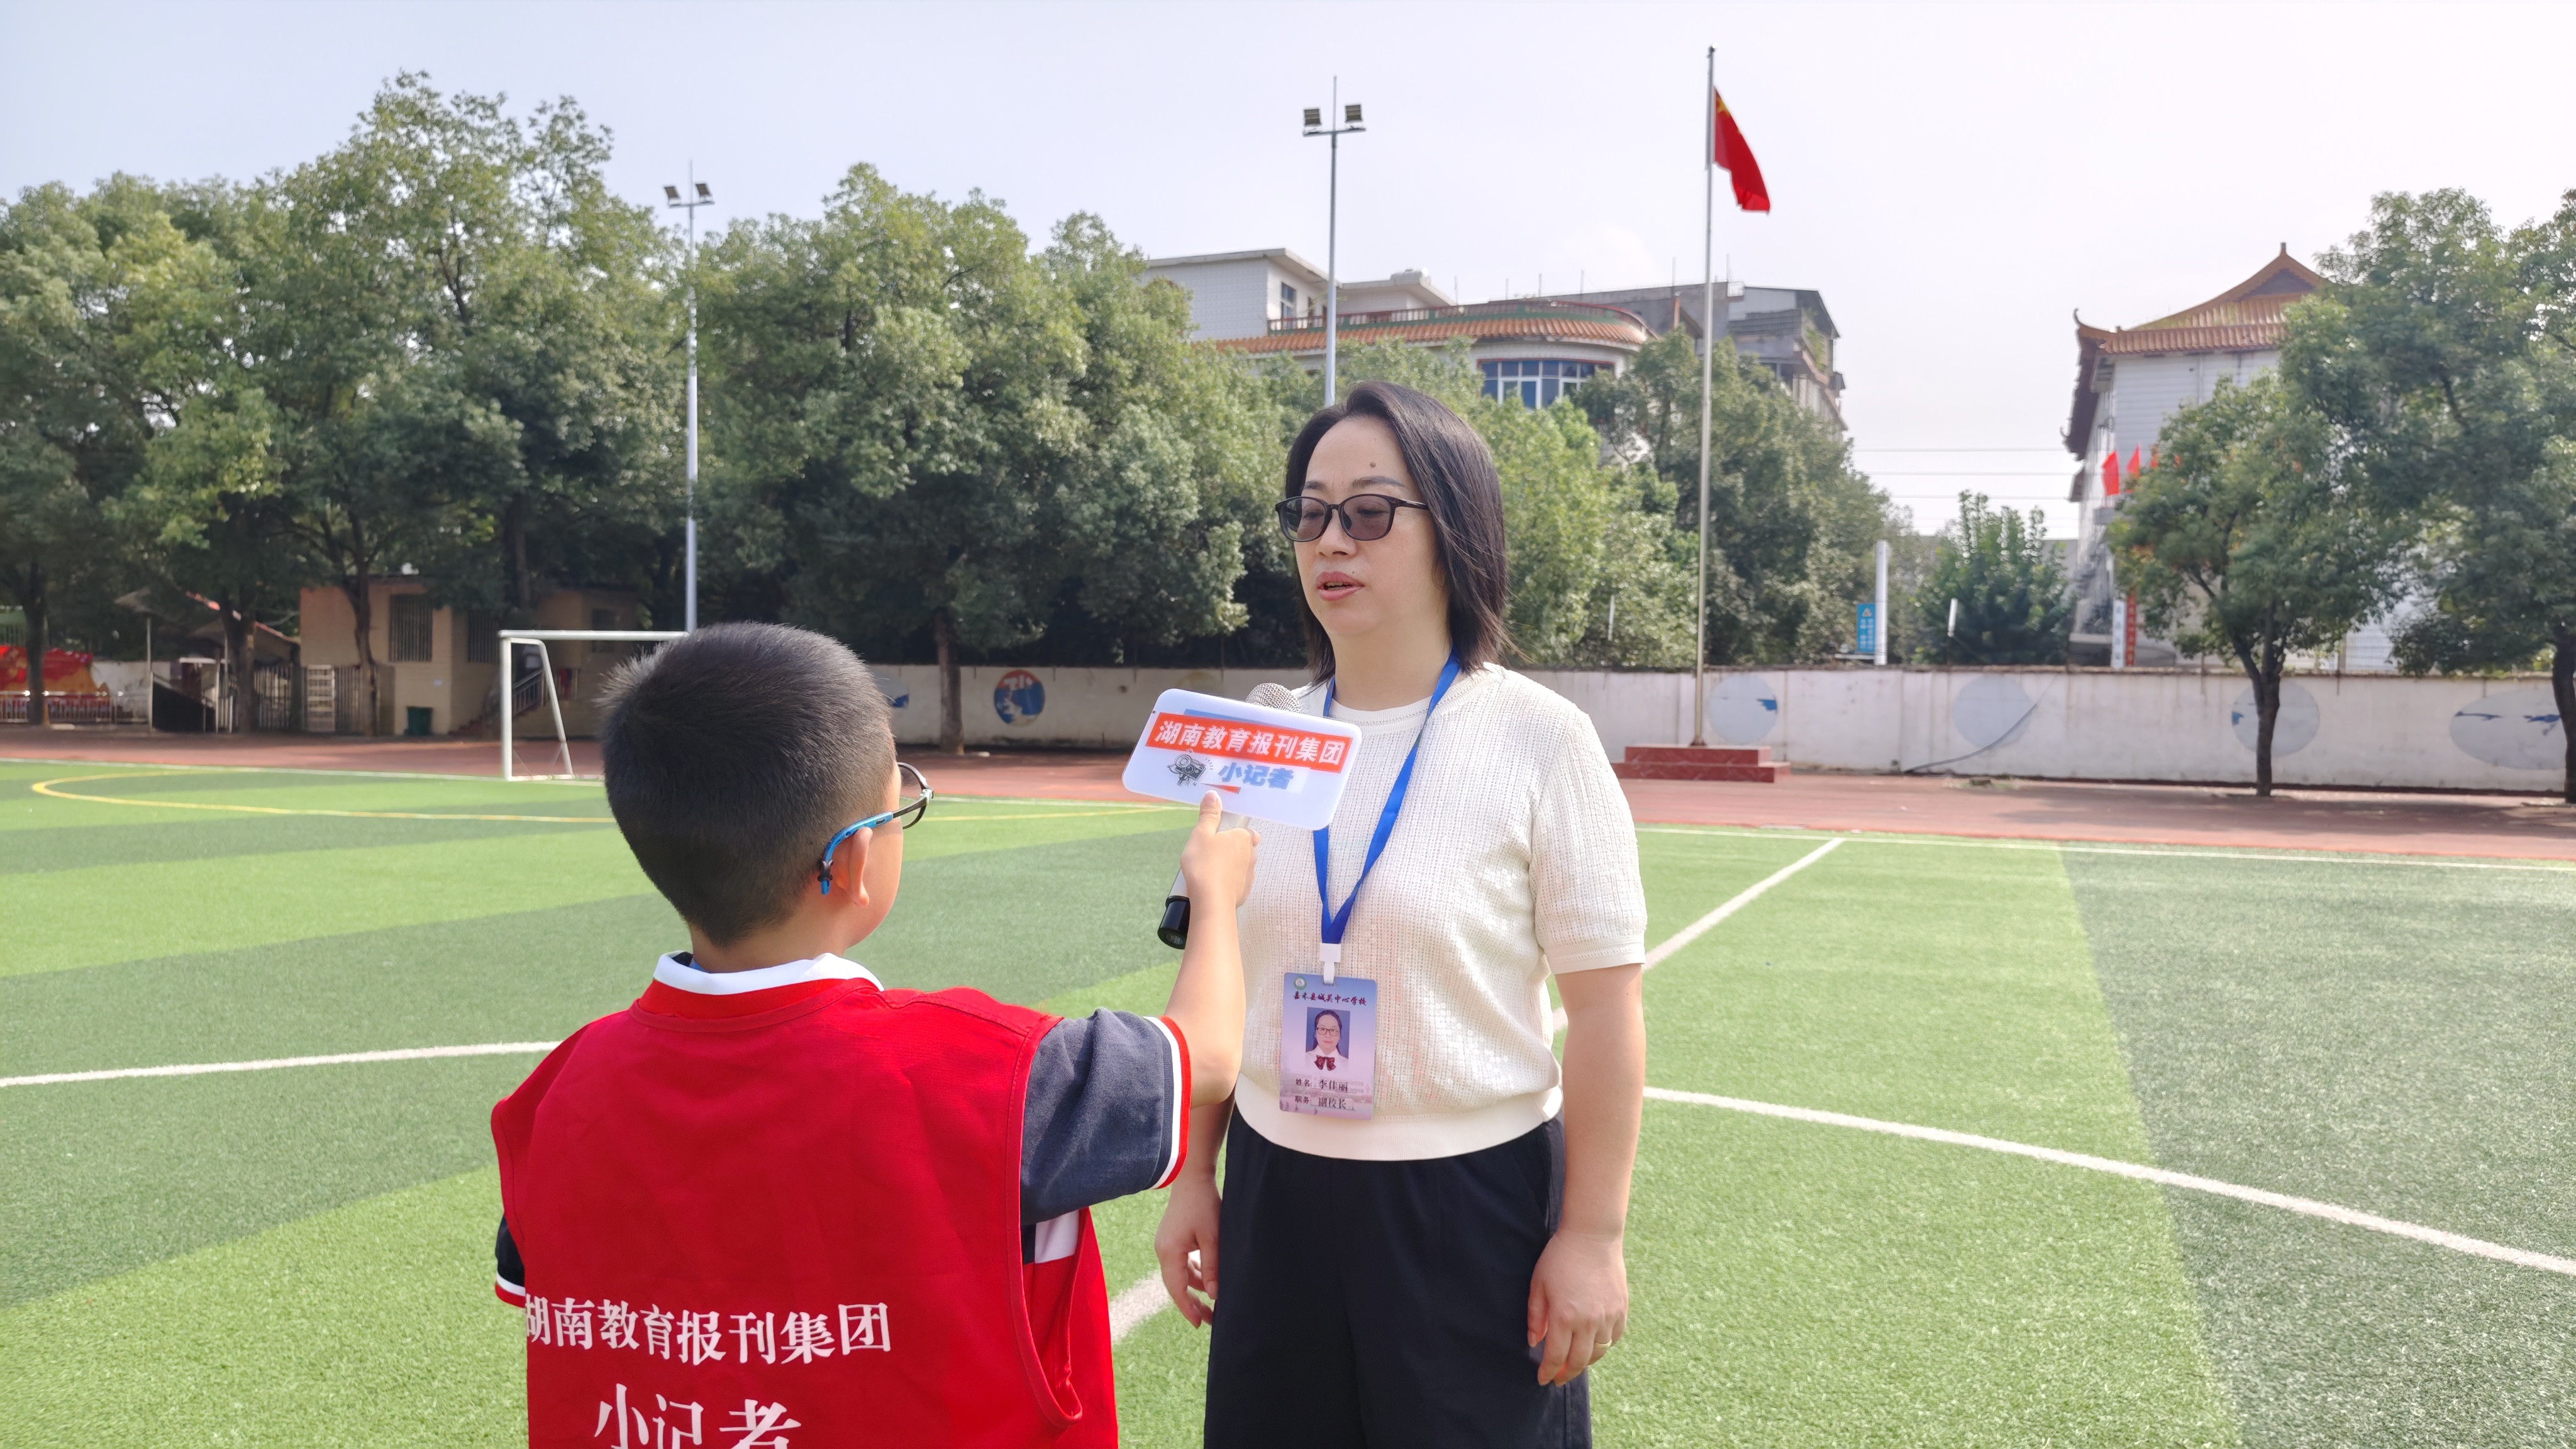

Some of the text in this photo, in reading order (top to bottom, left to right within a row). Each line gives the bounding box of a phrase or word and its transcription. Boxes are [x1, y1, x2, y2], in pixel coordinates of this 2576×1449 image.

[1155, 719, 1345, 765] 湖南教育报刊集团
[1218, 762, 1294, 789] 小记者
